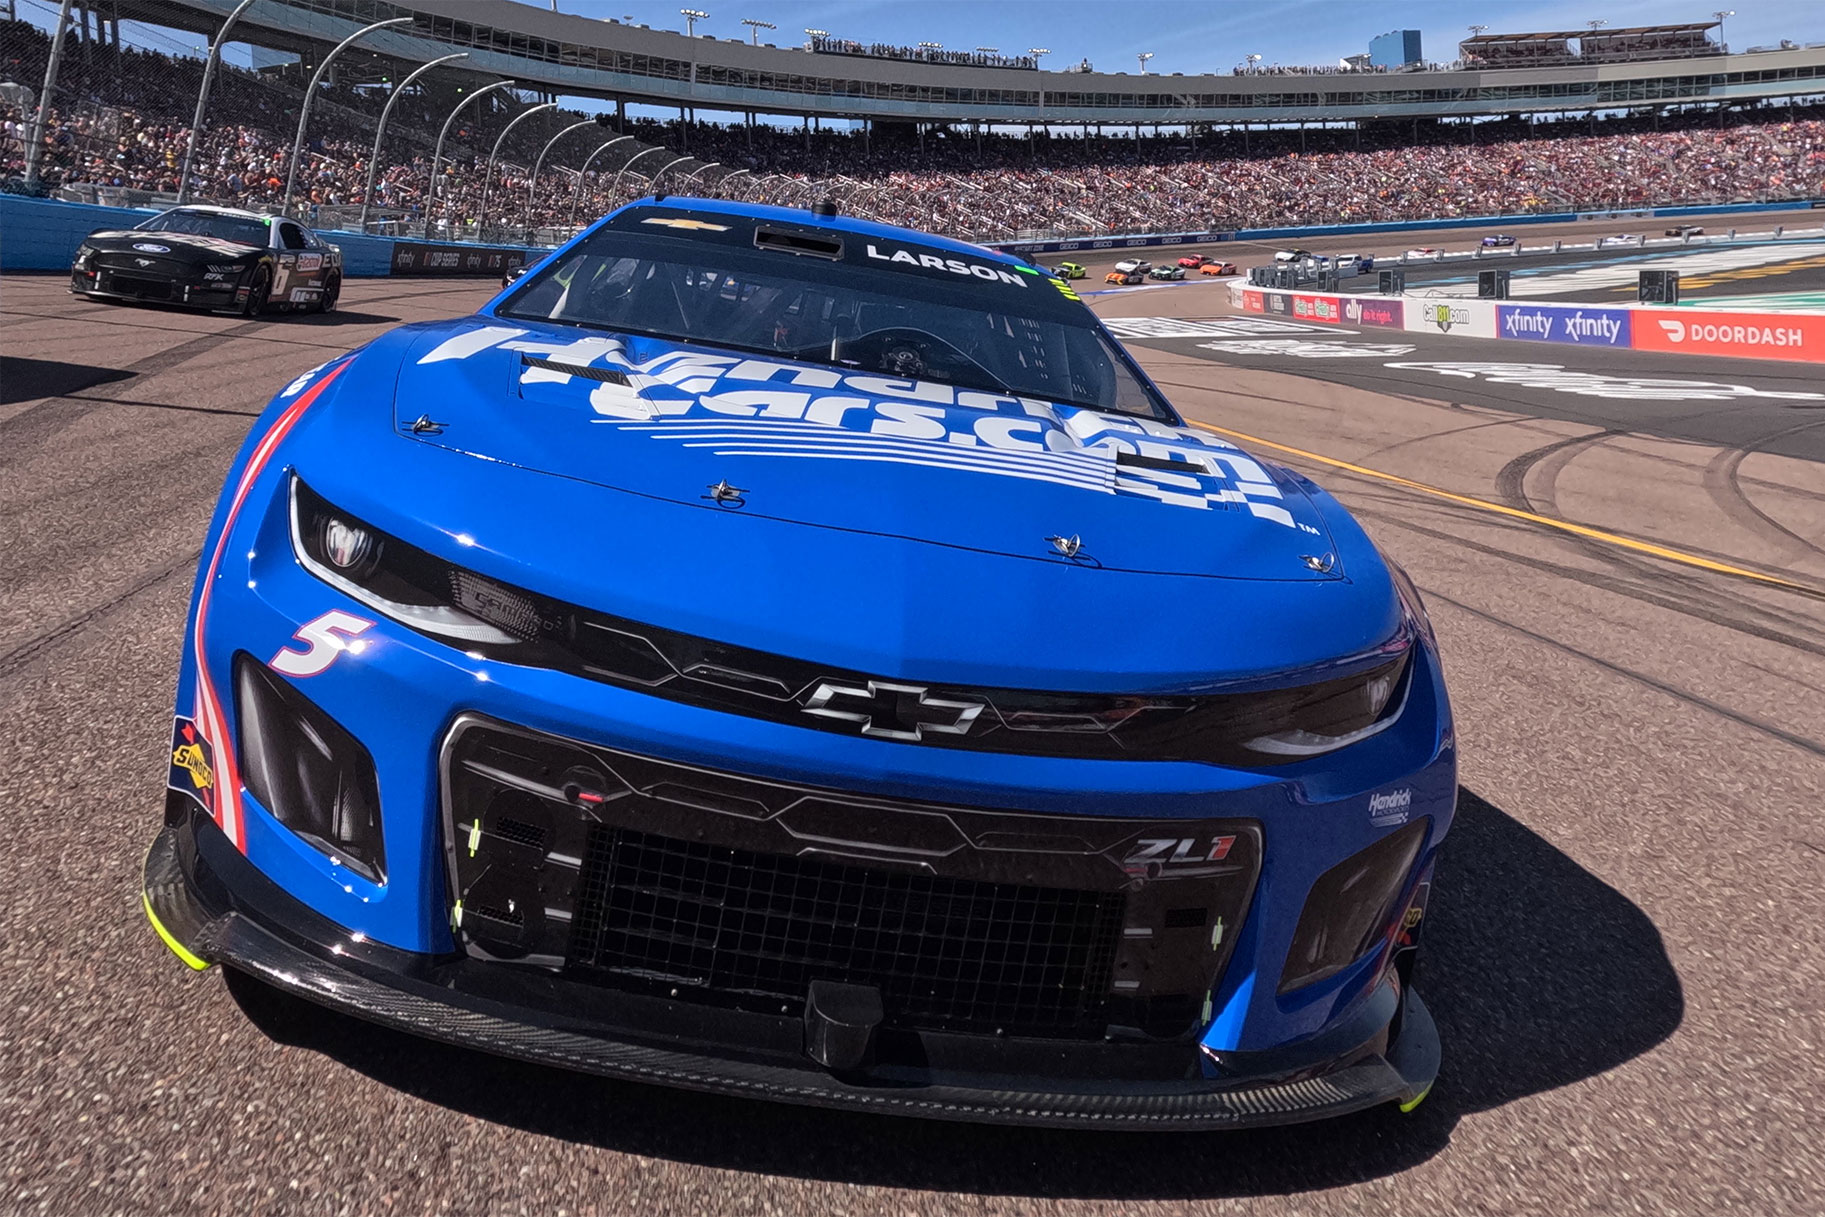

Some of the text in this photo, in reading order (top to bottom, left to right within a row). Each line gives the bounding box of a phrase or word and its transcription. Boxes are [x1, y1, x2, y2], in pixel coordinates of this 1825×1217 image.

[1059, 242, 1079, 250] GEICO
[1093, 240, 1112, 248] GEICO
[1127, 238, 1147, 246] GEICO
[1162, 236, 1182, 244] GEICO
[866, 244, 1028, 288] LARSON
[1346, 299, 1363, 325] ally
[1423, 304, 1470, 325] Call811.com
[1505, 308, 1621, 344] xfinity xfinity
[1691, 324, 1803, 346] DOORDASH
[267, 608, 378, 678] 5
[176, 748, 213, 787] SUNOCO
[1368, 788, 1412, 817] Hendrick
[1123, 834, 1237, 864] ZL1
